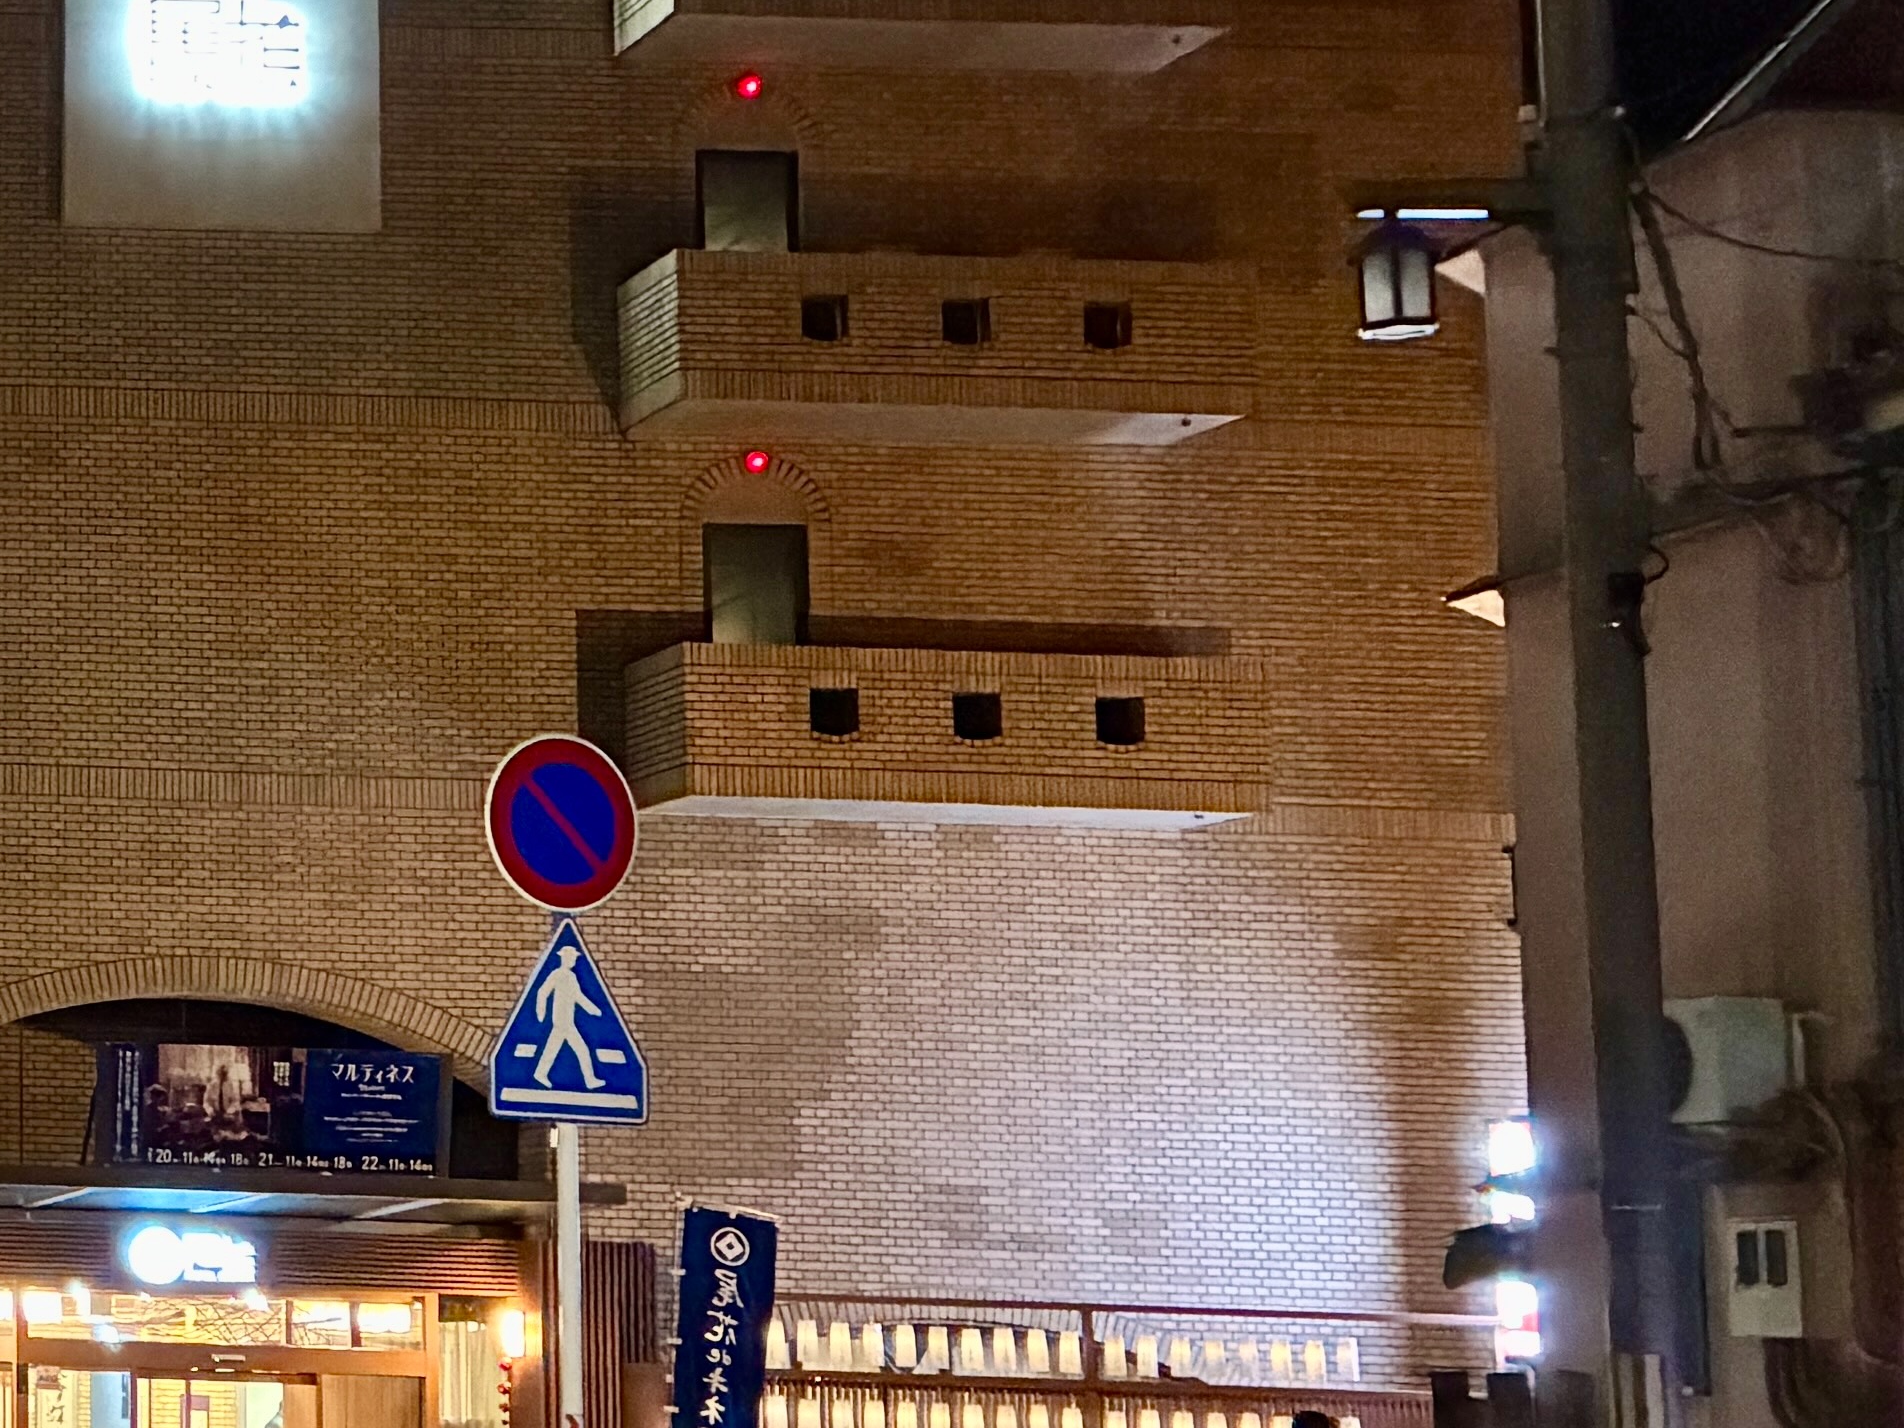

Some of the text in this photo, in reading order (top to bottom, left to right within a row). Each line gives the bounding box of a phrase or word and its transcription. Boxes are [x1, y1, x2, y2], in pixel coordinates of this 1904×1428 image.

[331, 1063, 415, 1084] マルティネス
